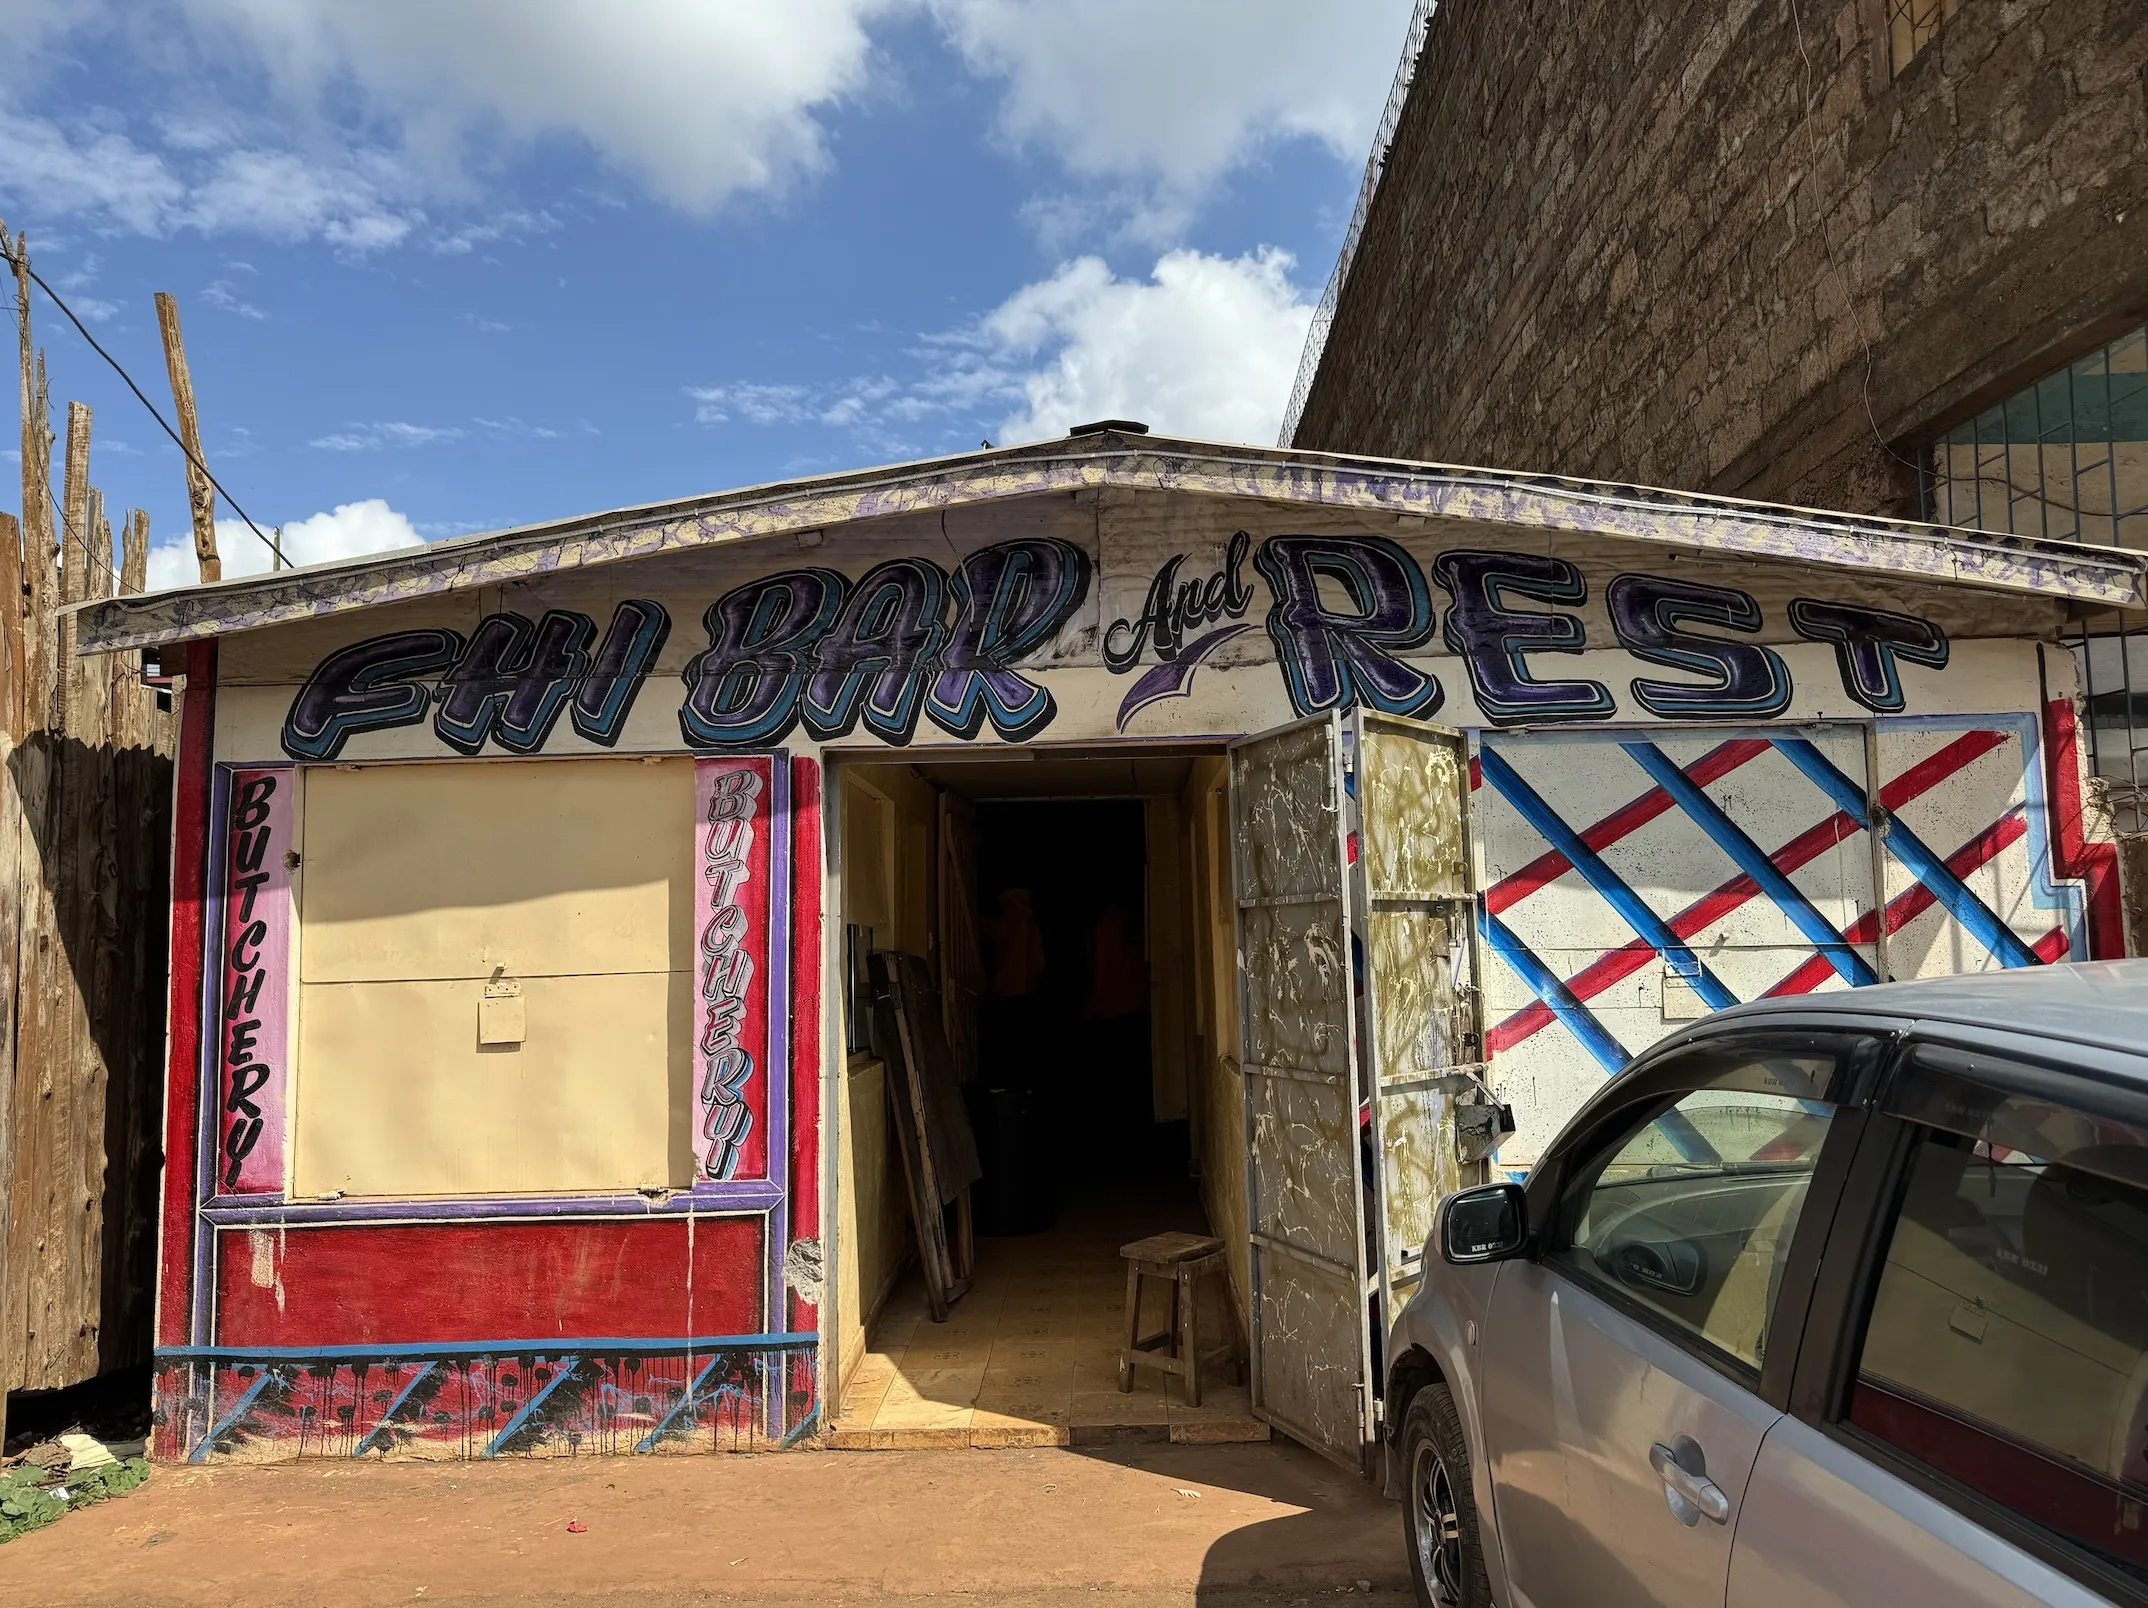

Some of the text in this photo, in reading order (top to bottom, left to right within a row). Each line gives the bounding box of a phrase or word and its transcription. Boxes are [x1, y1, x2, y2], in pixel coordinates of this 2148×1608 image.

[679, 536, 1091, 747] BAR
[1102, 530, 1255, 675] And
[1253, 534, 1949, 725] REST
[225, 776, 277, 1186] BUTCHERY
[701, 769, 763, 1181] BUTCHERY
